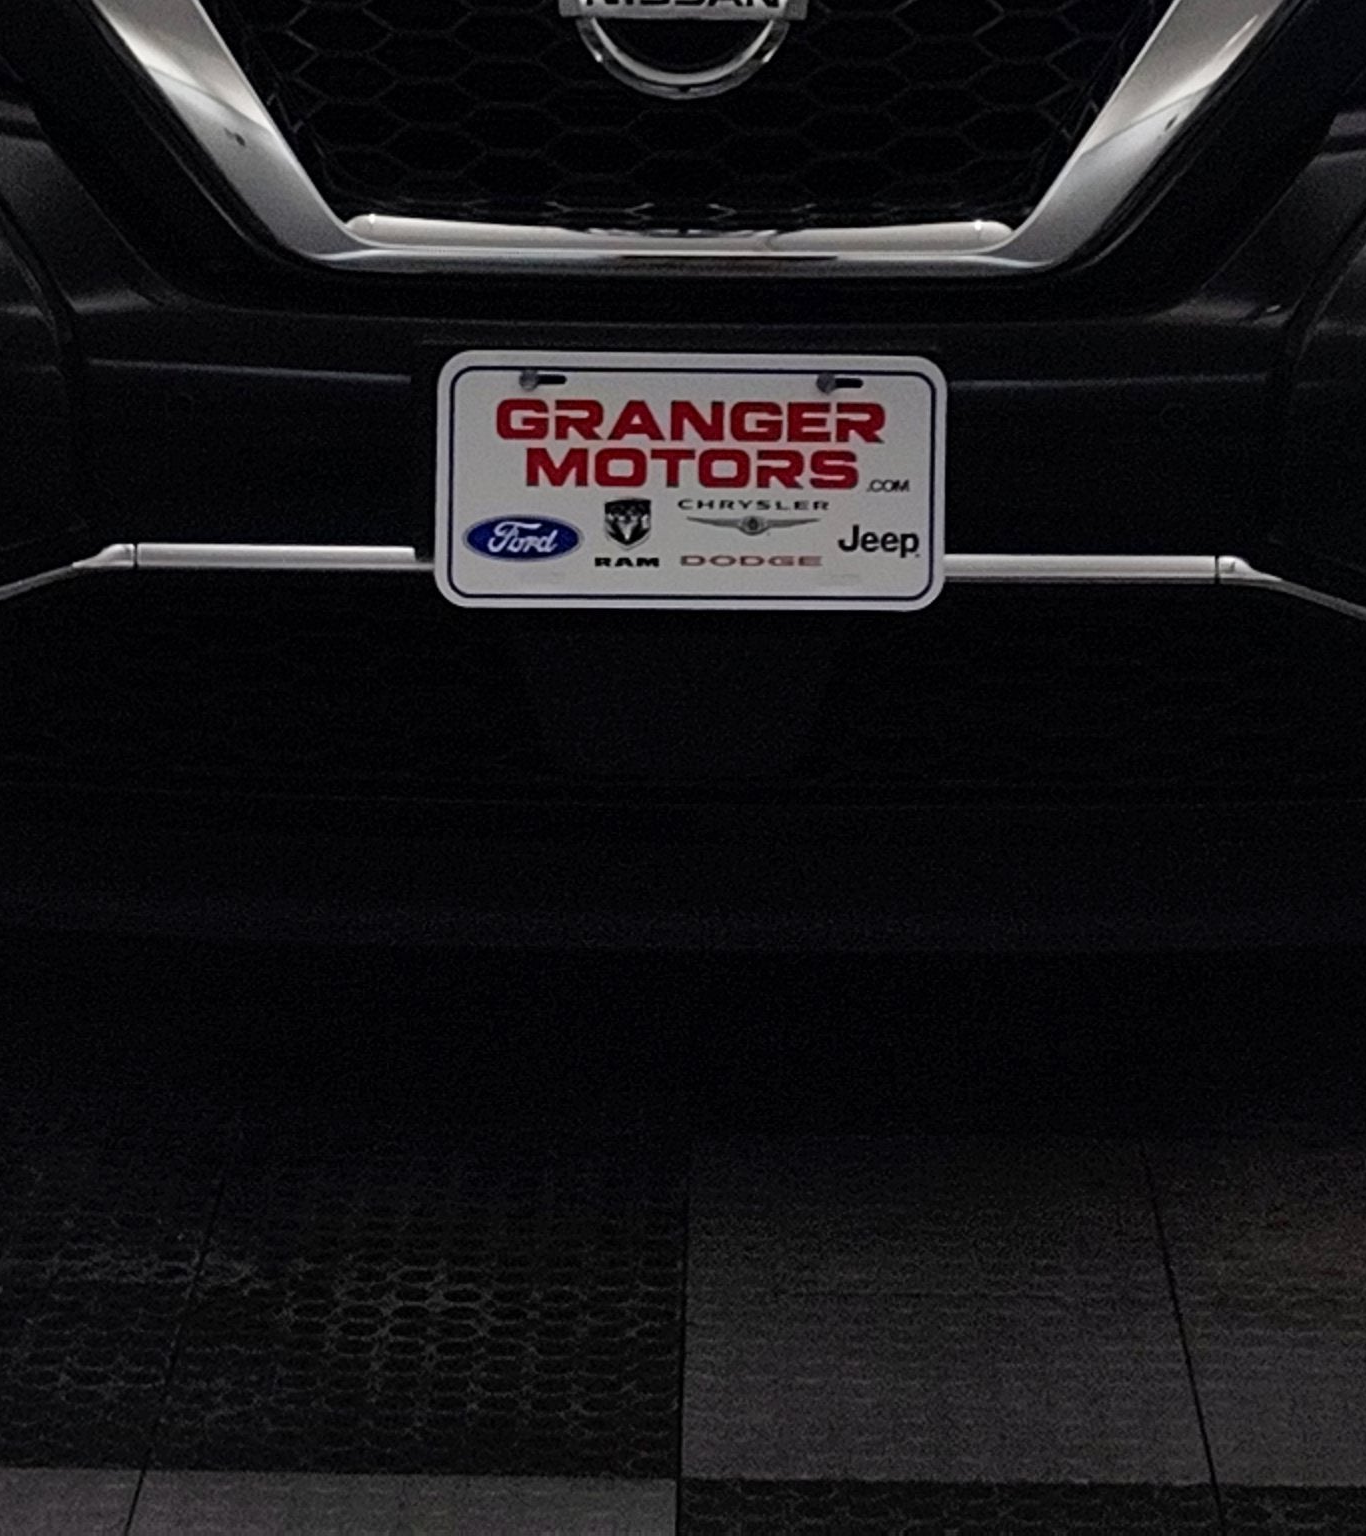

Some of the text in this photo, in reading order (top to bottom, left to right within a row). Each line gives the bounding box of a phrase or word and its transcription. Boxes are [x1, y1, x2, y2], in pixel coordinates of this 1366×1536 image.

[495, 398, 886, 444] GRANGER
[524, 447, 860, 490] MOTORS
[677, 498, 830, 511] CHRYSLER
[486, 520, 558, 555] Ford
[837, 524, 920, 558] Jeep
[594, 556, 660, 568] RAM
[680, 555, 823, 567] DODGE
